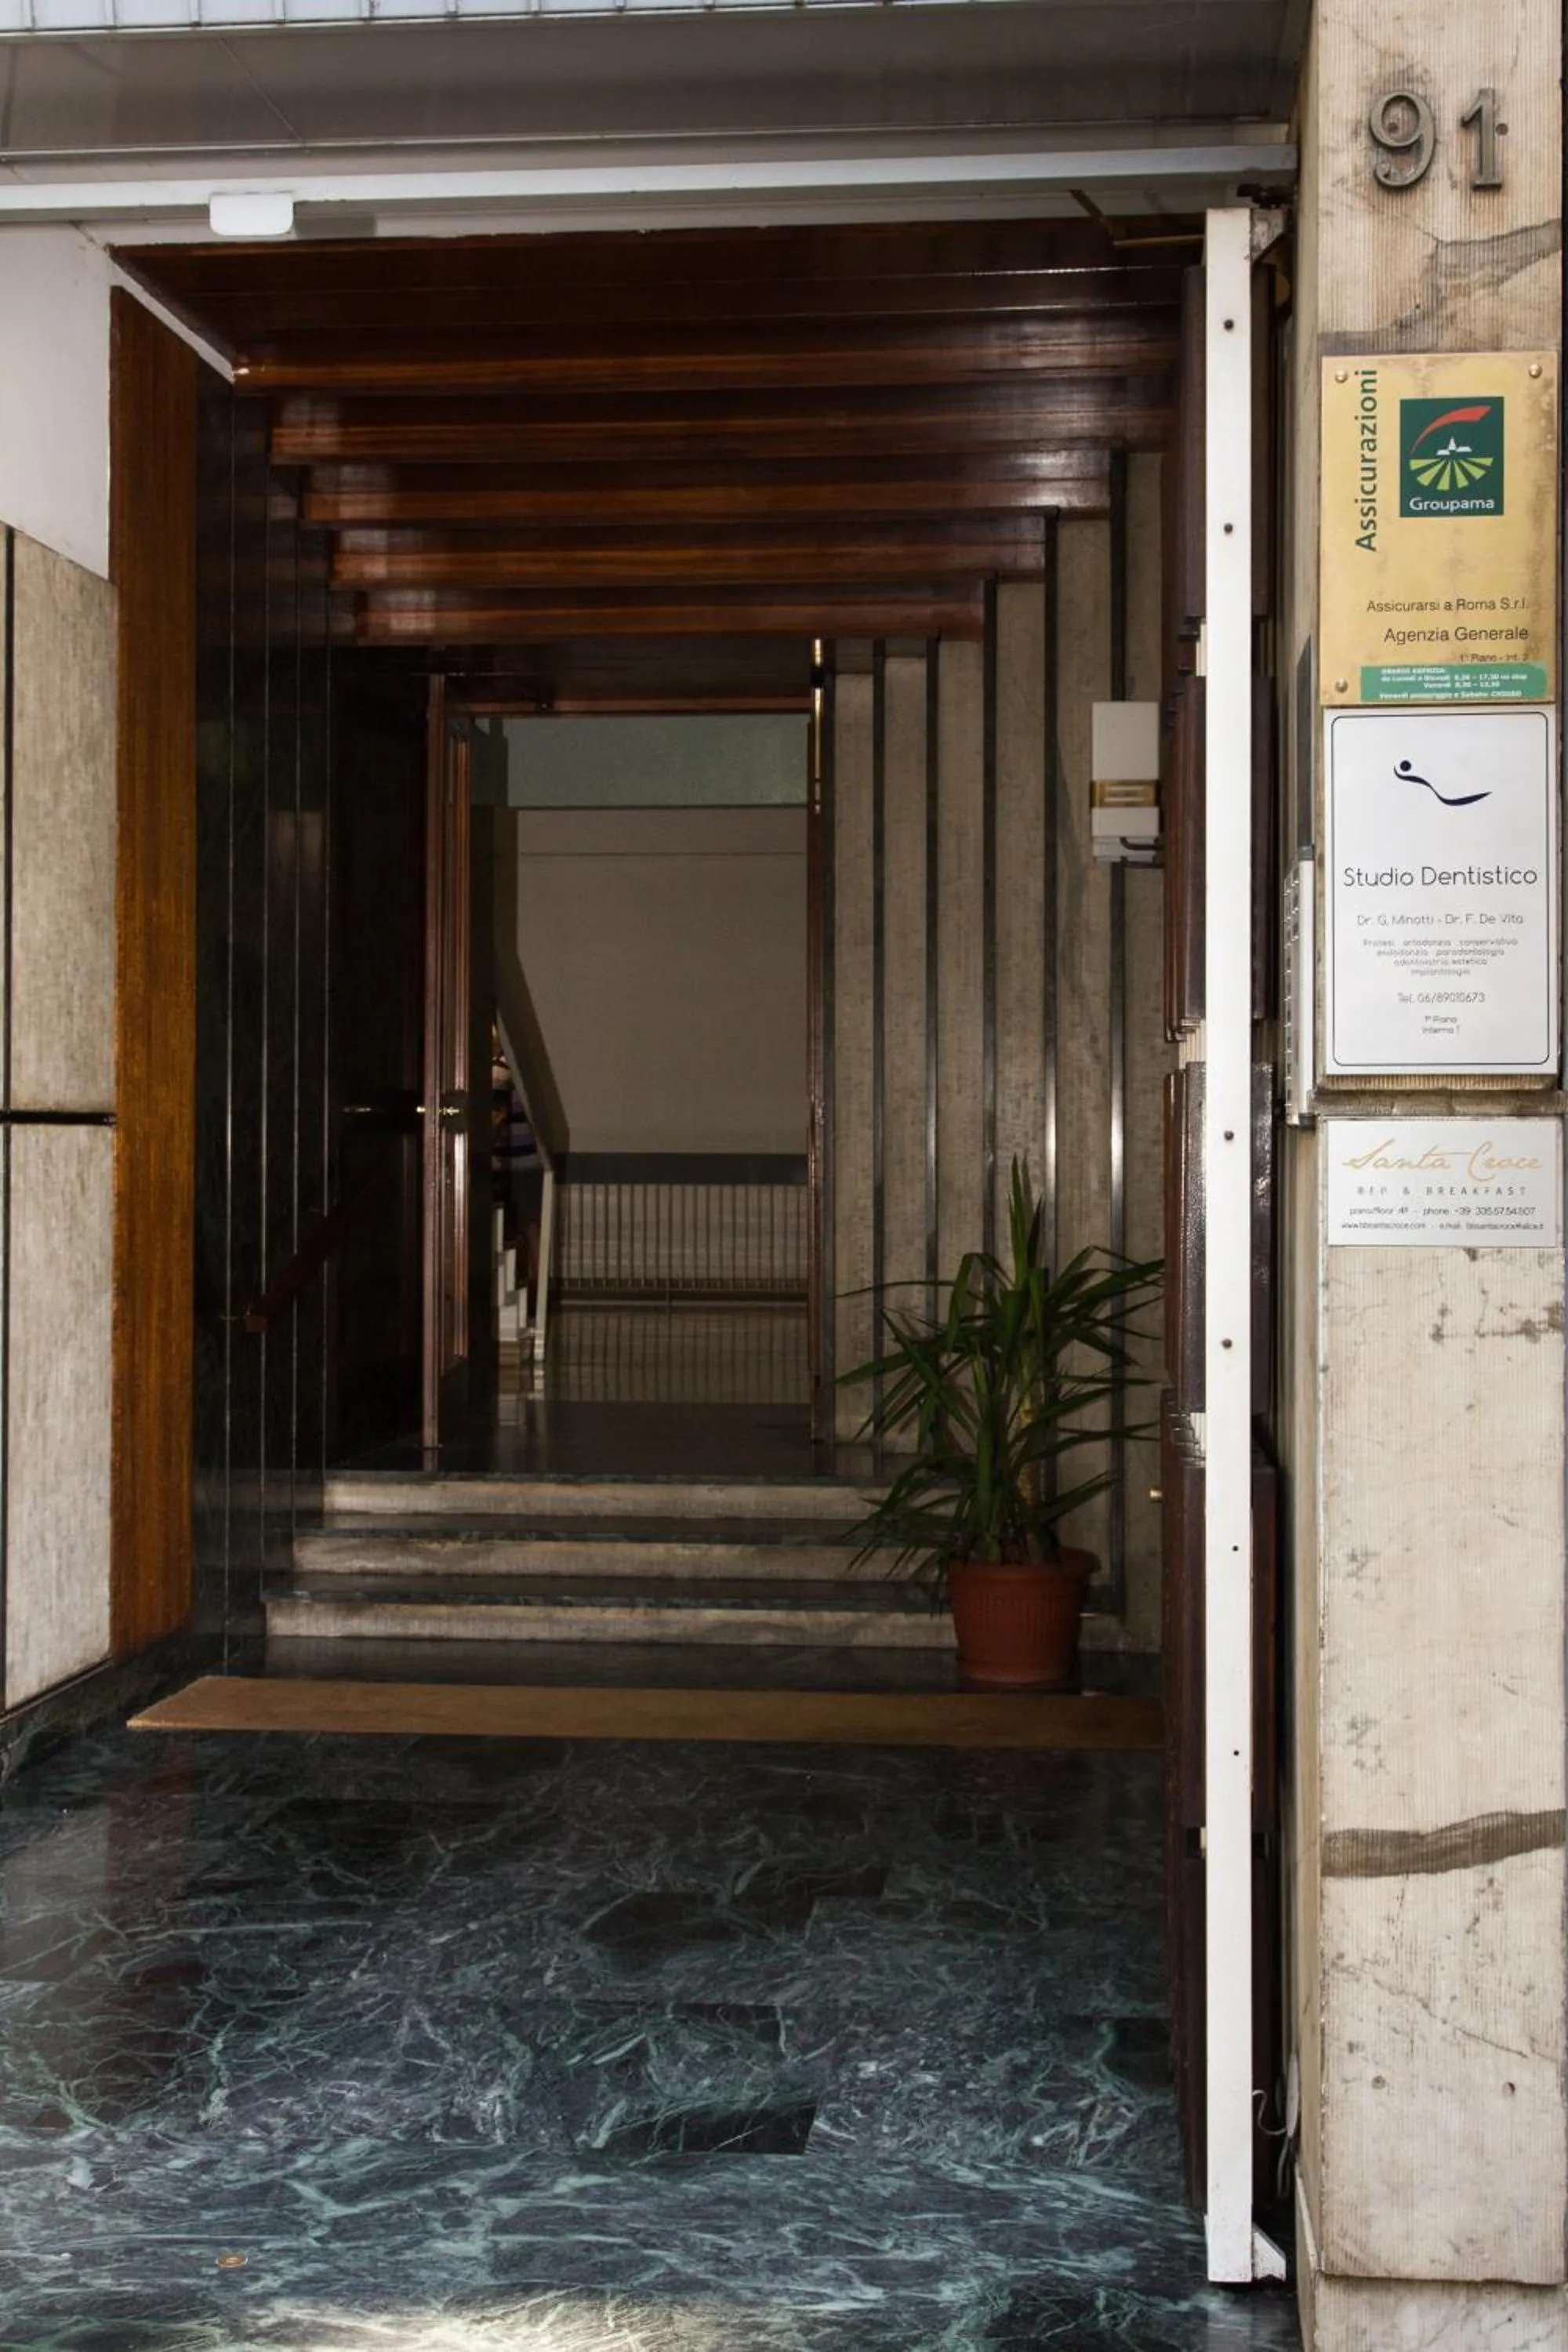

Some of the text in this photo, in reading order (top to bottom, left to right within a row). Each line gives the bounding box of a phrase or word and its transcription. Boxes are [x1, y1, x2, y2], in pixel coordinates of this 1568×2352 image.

[1369, 88, 1503, 191] 91
[1355, 368, 1377, 553] Assicurazioni
[1409, 496, 1495, 512] Groupama
[1367, 597, 1529, 612] Assicurarsi a Roma S.r.l.
[1384, 626, 1529, 645] Agenzia Generale
[1471, 653, 1497, 662] Piano
[1343, 865, 1538, 887] Studio Dentistico
[1392, 914, 1435, 925] Minotti
[1445, 913, 1464, 925] Dr.
[1479, 913, 1497, 924] De
[1341, 1138, 1544, 1182] Santa Croce
[1425, 1185, 1527, 1196] BREAKFAST
[1423, 1207, 1450, 1216] phone
